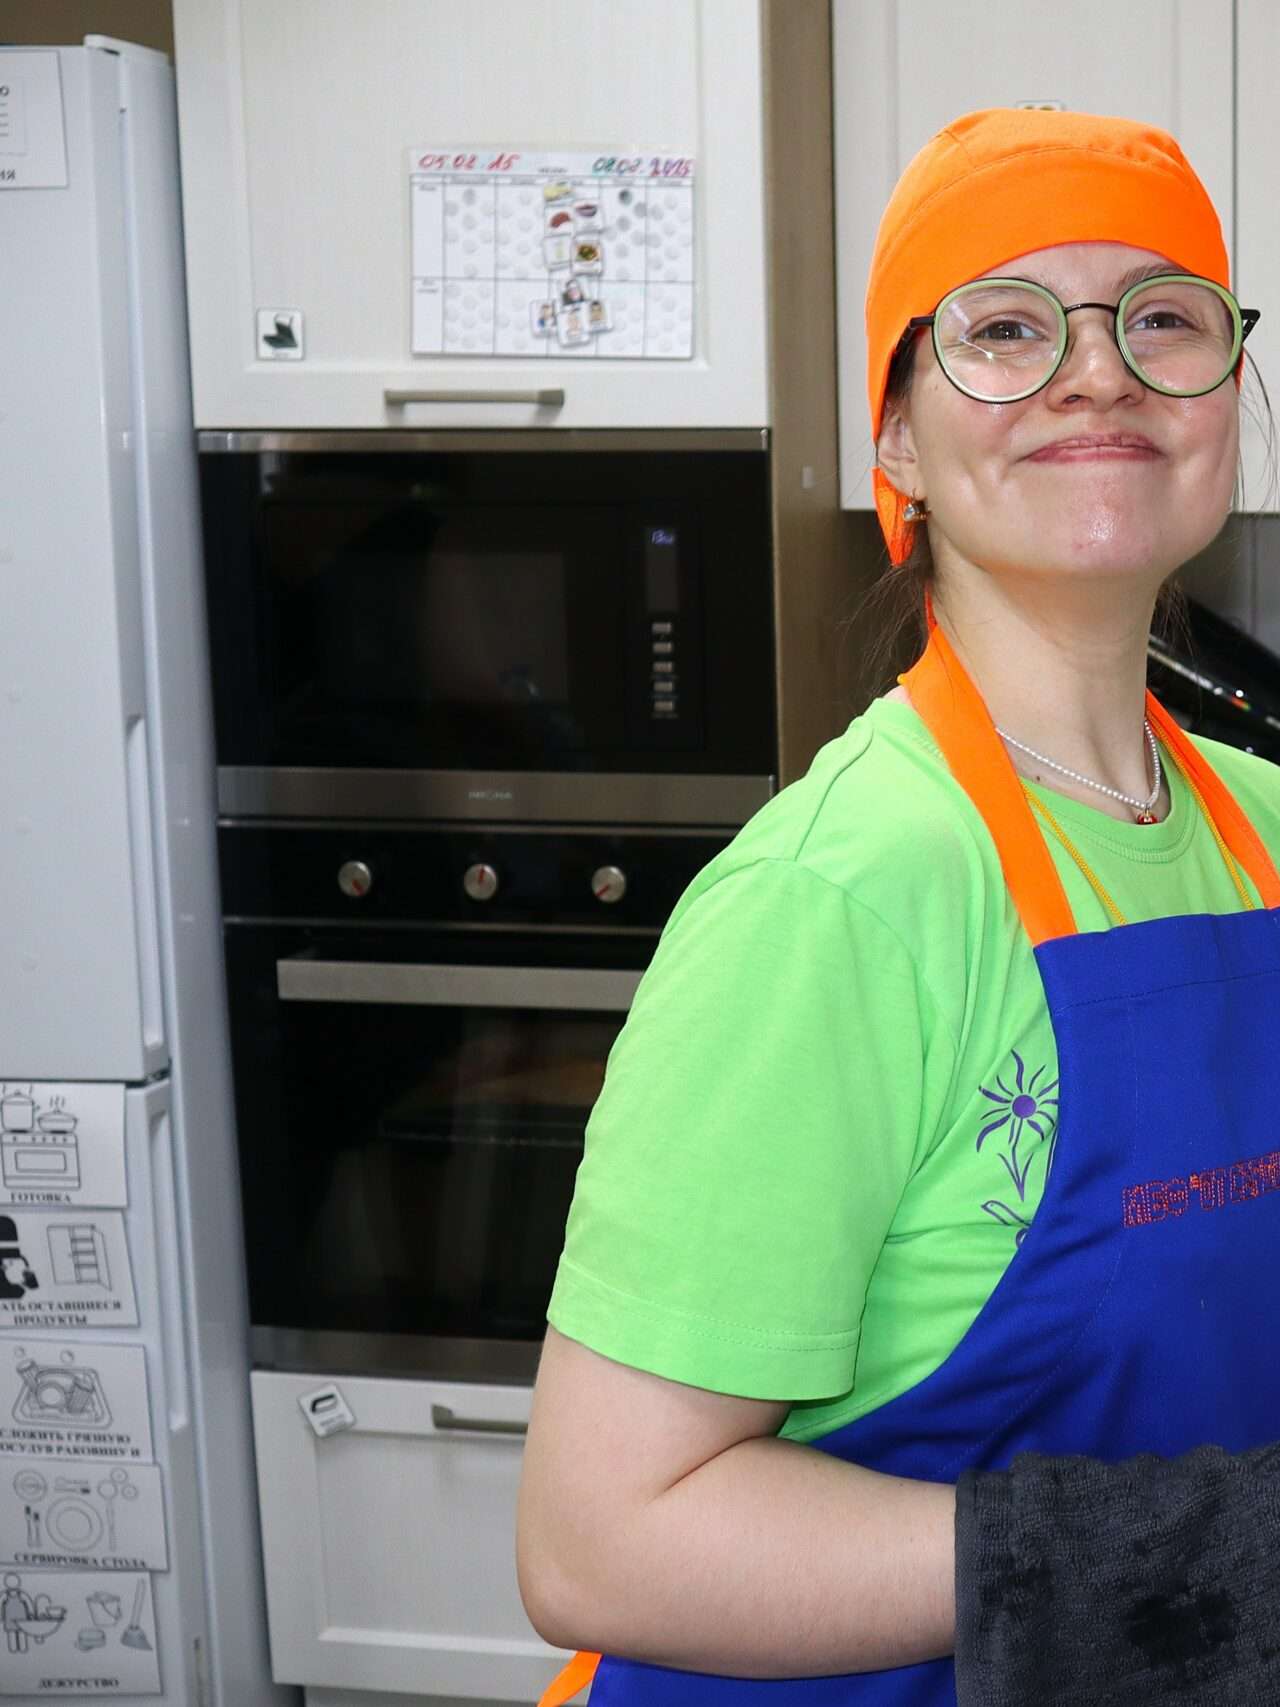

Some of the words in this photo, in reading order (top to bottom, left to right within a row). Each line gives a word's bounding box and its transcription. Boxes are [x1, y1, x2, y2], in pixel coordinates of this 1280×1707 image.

[11, 1191, 71, 1203] ГОТОВКА
[28, 1301, 120, 1312] ОСТАВШИЕСЯ
[14, 1314, 87, 1326] ПРОДУКТЫ
[57, 1445, 126, 1457] РАКОВИНУ
[39, 1678, 120, 1689] ДЕЖУРСТВО
